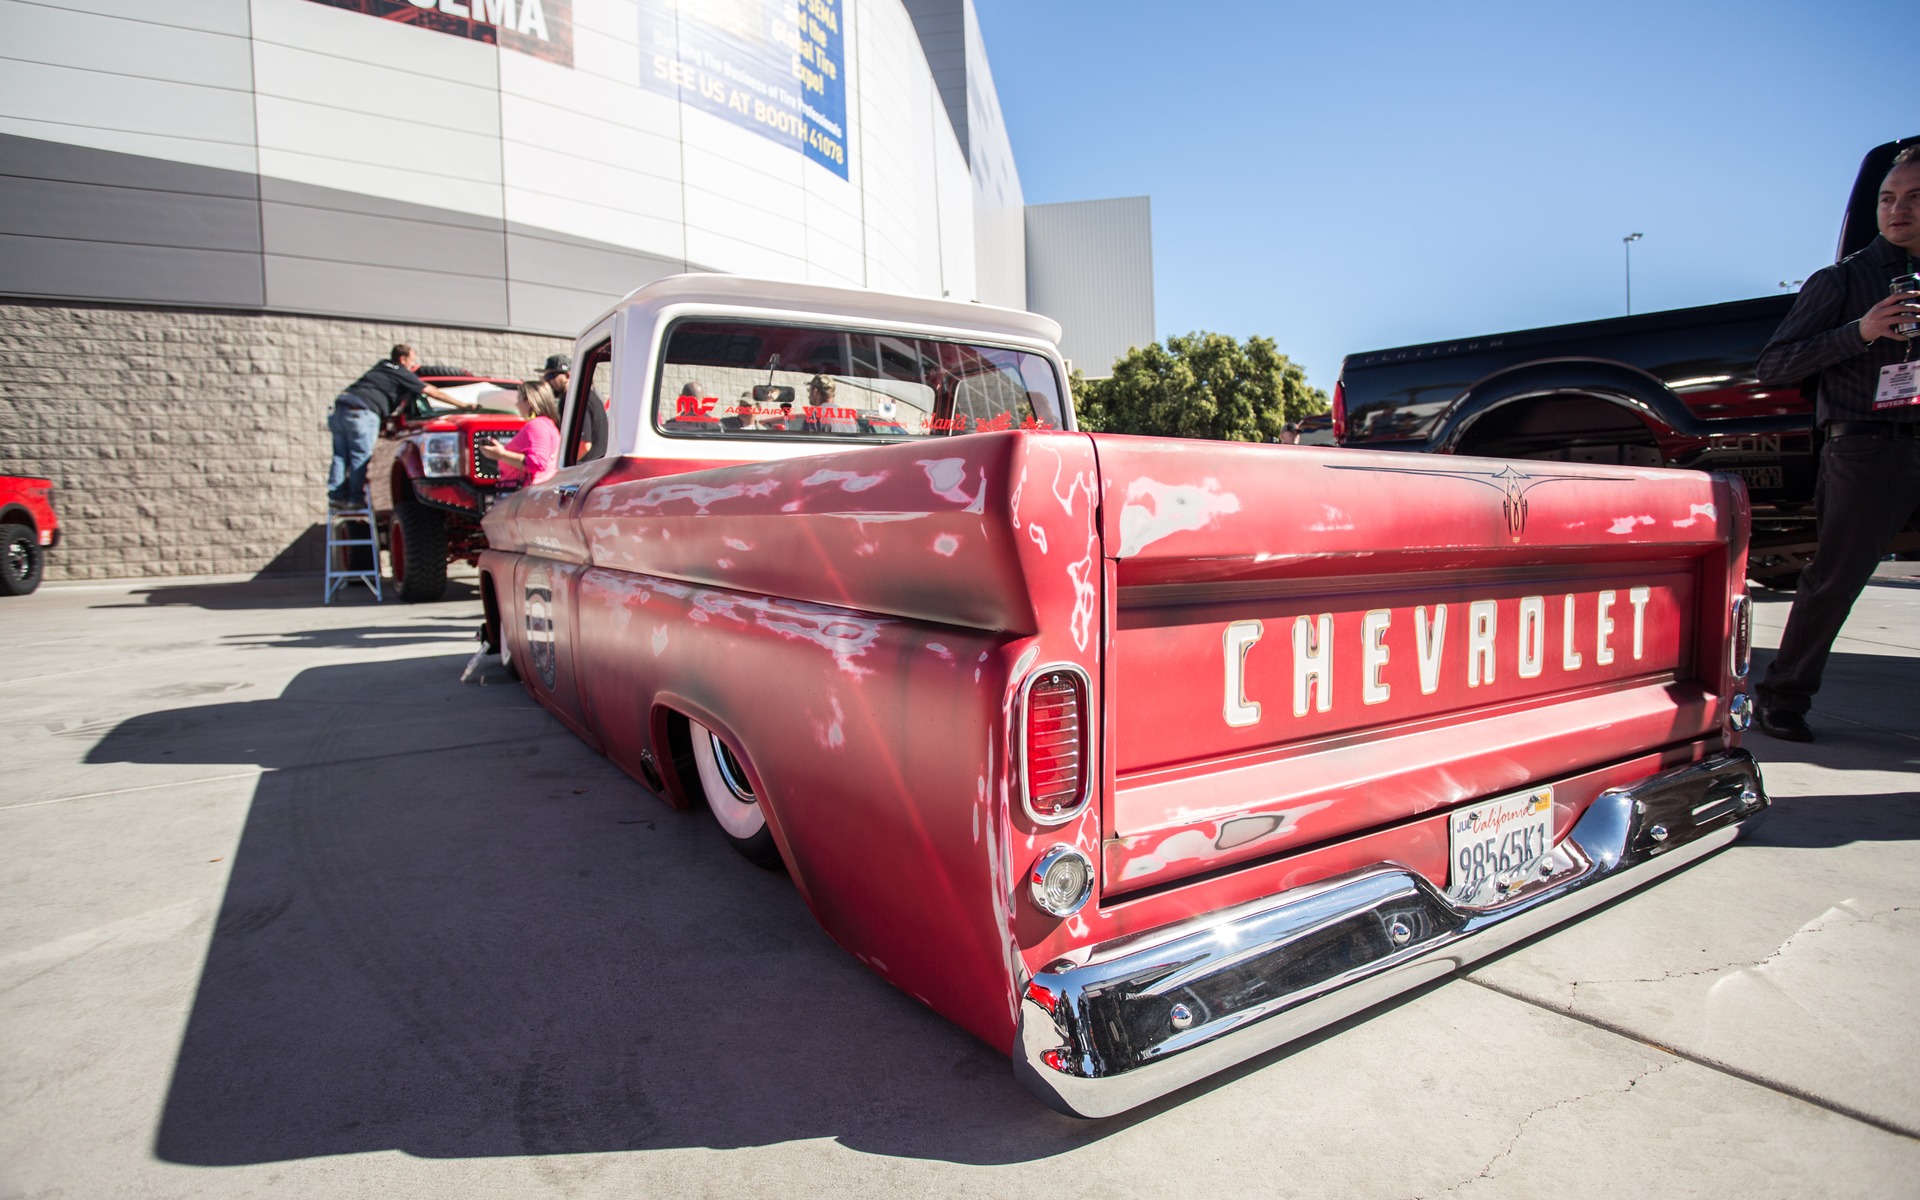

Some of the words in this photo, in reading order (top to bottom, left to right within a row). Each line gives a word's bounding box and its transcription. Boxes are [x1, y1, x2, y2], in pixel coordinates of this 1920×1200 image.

[407, 0, 550, 42] MA
[791, 54, 824, 96] Expo!
[815, 45, 837, 80] Tire
[653, 55, 696, 91] SEE
[700, 72, 725, 104] US
[729, 89, 751, 115] AT
[754, 99, 808, 141] BOOTH
[810, 130, 844, 164] 41078
[768, 84, 778, 99] of
[802, 406, 858, 419] VIAIR
[1710, 435, 1781, 454] ICON
[1223, 586, 1651, 727] CHEVROLET
[1472, 805, 1535, 834] California
[1460, 822, 1545, 884] 98565K1
